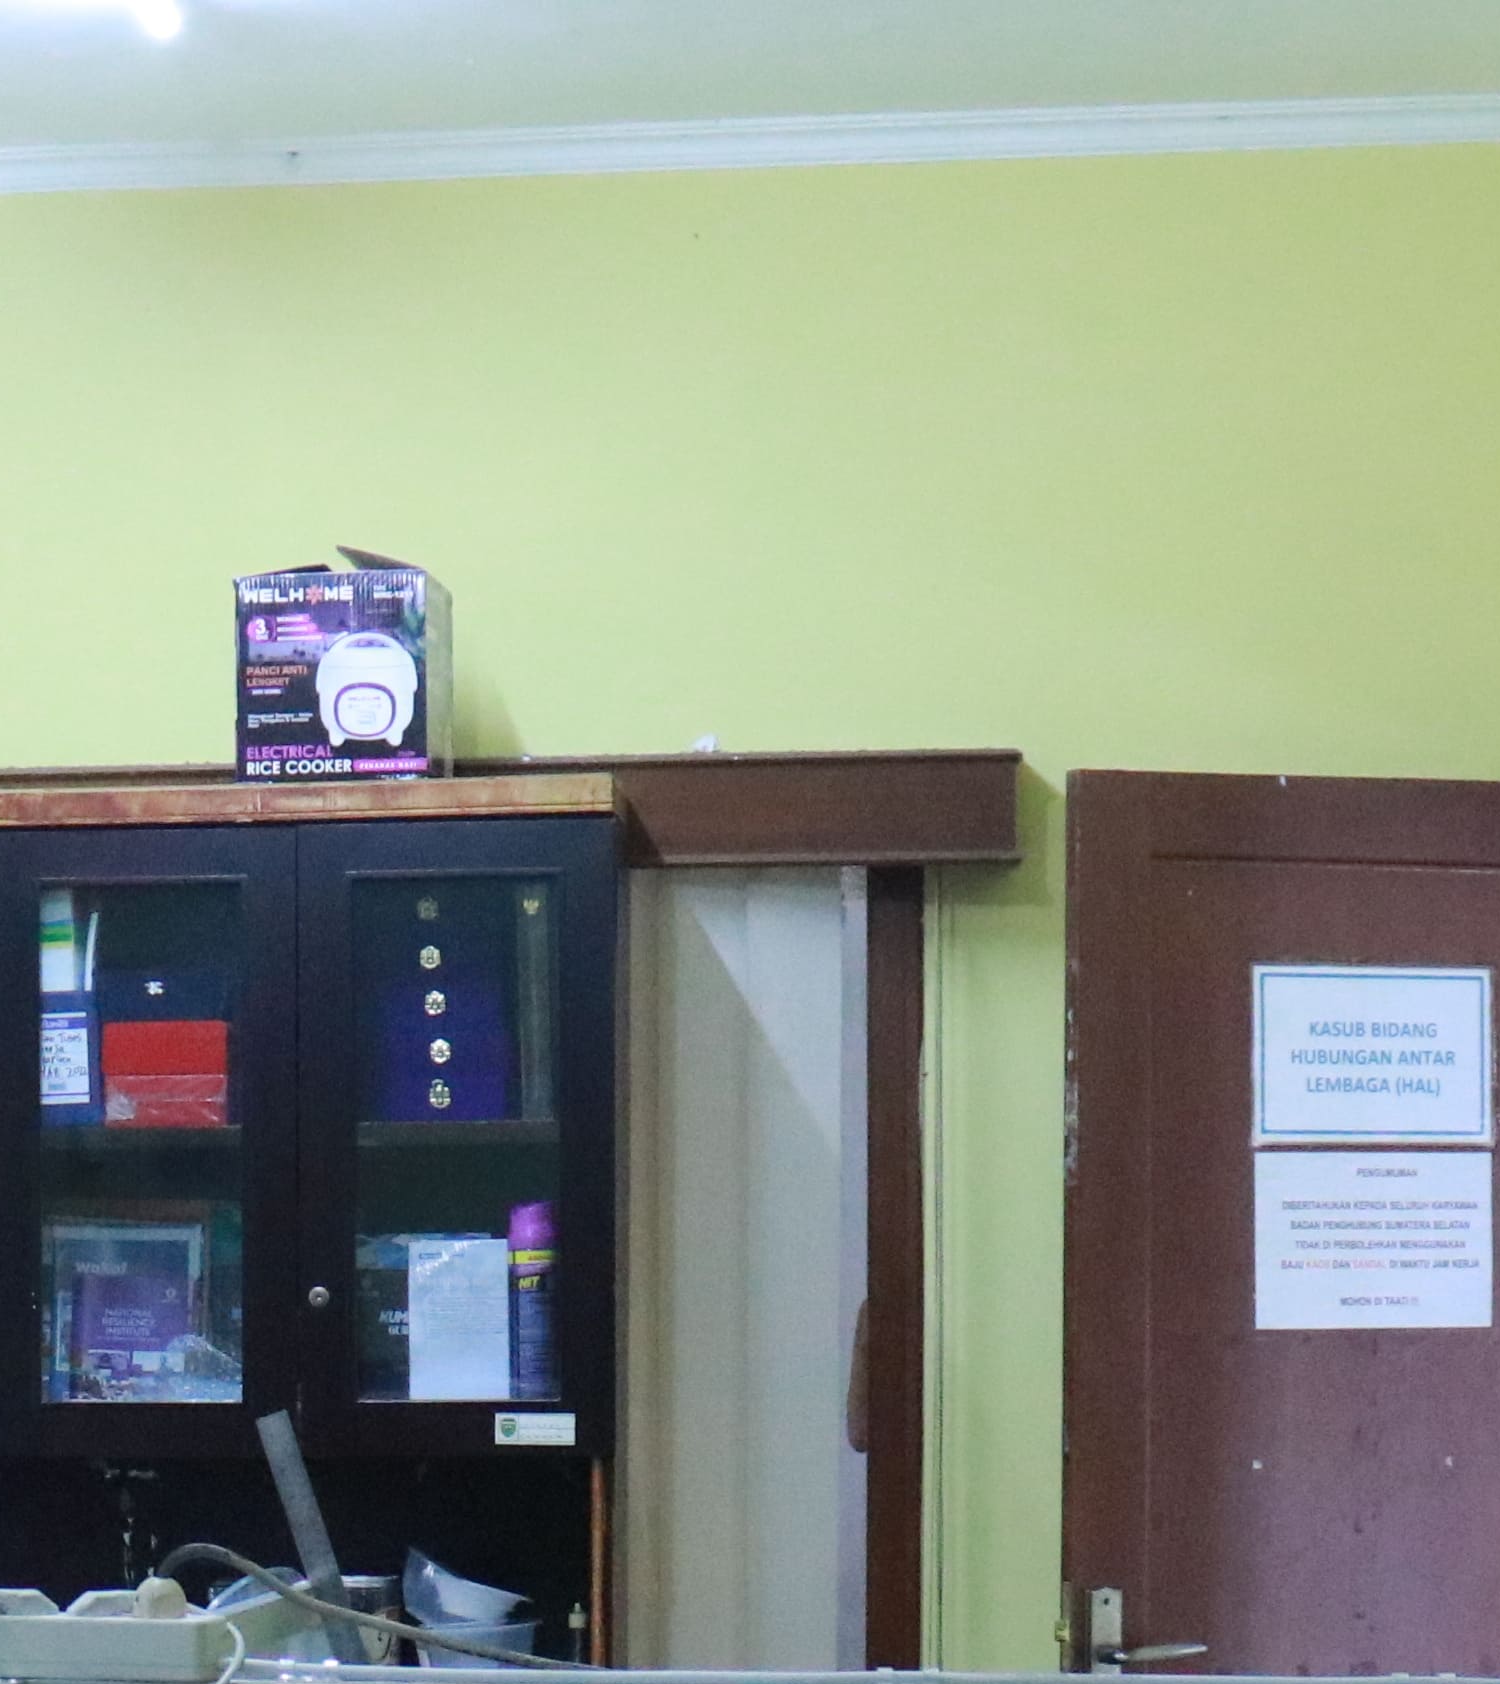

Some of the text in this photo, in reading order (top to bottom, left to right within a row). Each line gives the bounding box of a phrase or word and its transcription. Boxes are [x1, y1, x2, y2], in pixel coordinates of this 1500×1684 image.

[246, 744, 333, 759] ELECTRICAL
[246, 759, 353, 775] RICE COOKER
[1309, 1021, 1437, 1039] KASUB BIDANG
[1290, 1049, 1456, 1066] HUBUNGAN ANTAR
[1306, 1077, 1441, 1097] LEMBAGA (HAL)
[518, 1275, 542, 1290] HIT
